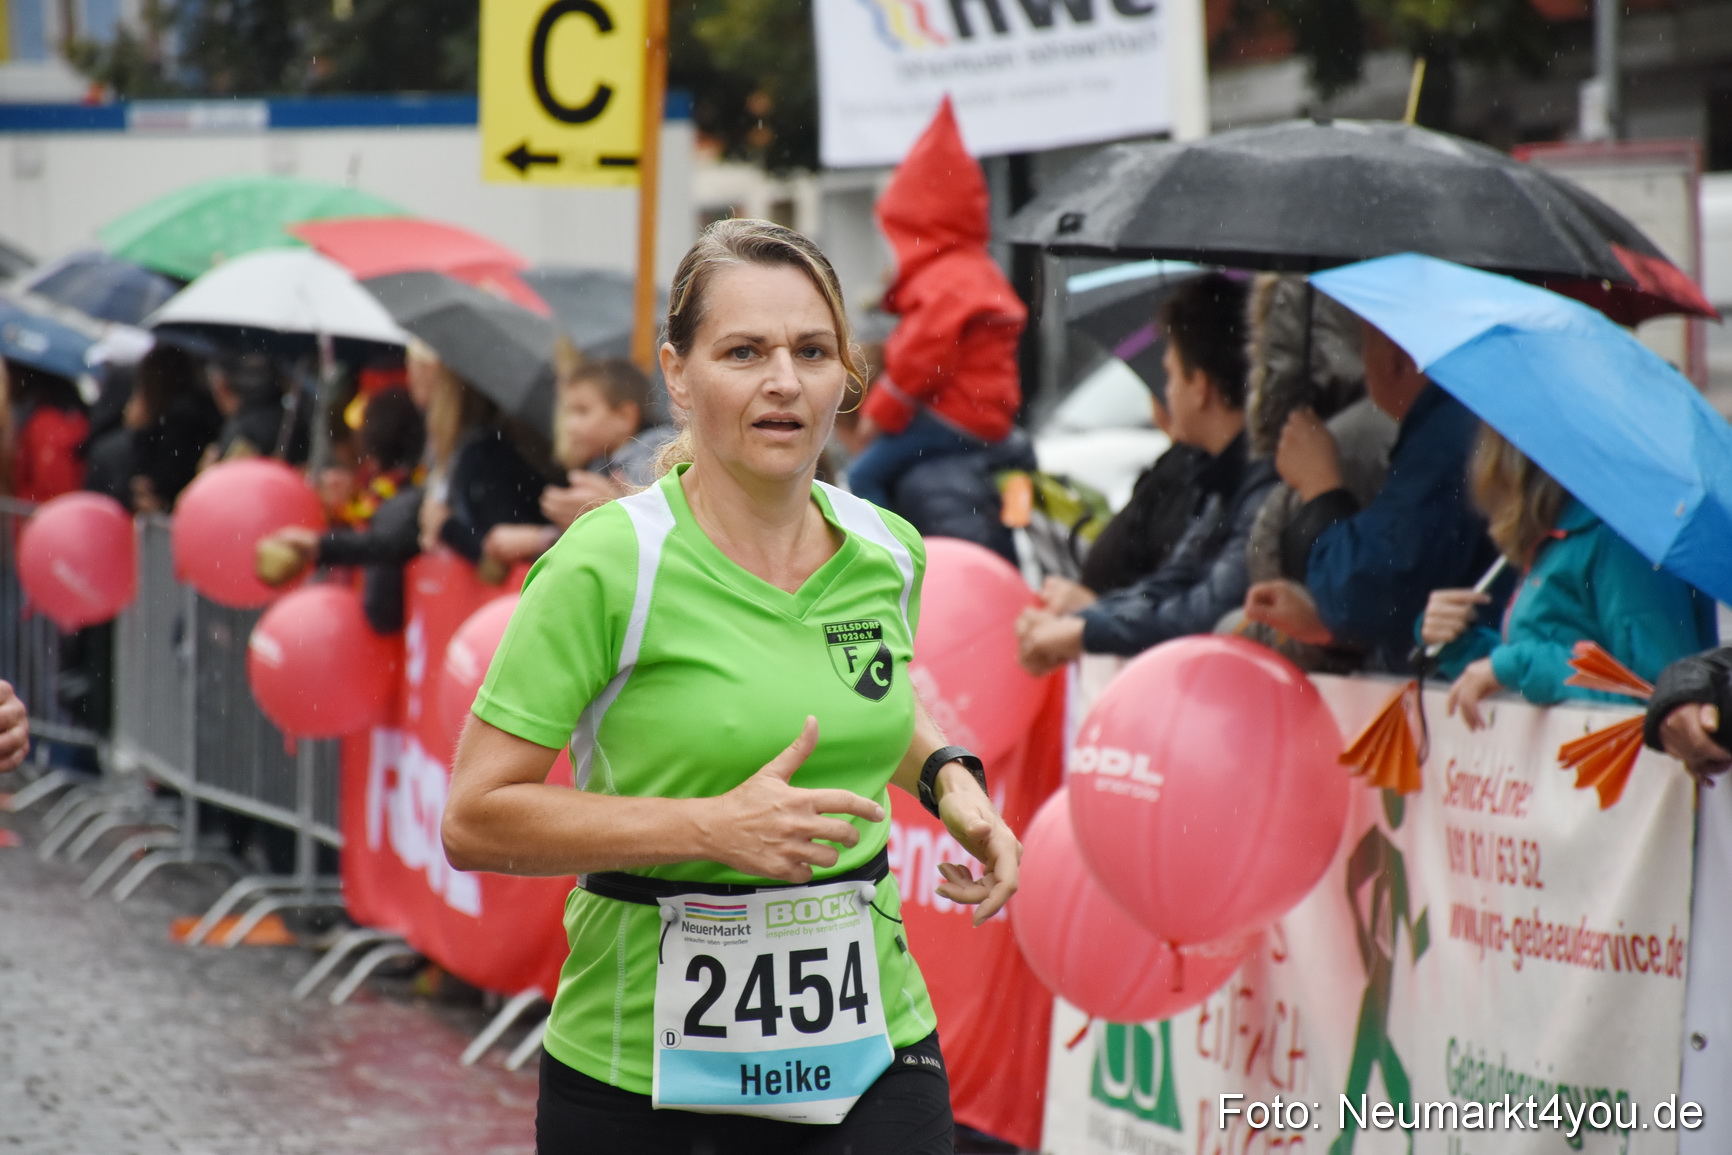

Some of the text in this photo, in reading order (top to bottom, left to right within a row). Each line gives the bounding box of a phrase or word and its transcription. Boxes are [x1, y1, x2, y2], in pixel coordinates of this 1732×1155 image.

[532, 0, 614, 123] C
[826, 621, 880, 634] EZELSDORF
[837, 631, 874, 641] 1923 e.V.
[843, 646, 889, 687] F C
[765, 890, 858, 929] BOCK
[681, 920, 751, 937] NeuerMarkt
[766, 928, 801, 939] inspired
[803, 927, 813, 936] by
[815, 924, 838, 934] smart
[684, 941, 869, 1038] 2454
[666, 1031, 675, 1046] D
[920, 1055, 941, 1069] JAKO
[740, 1060, 831, 1096] Heike
